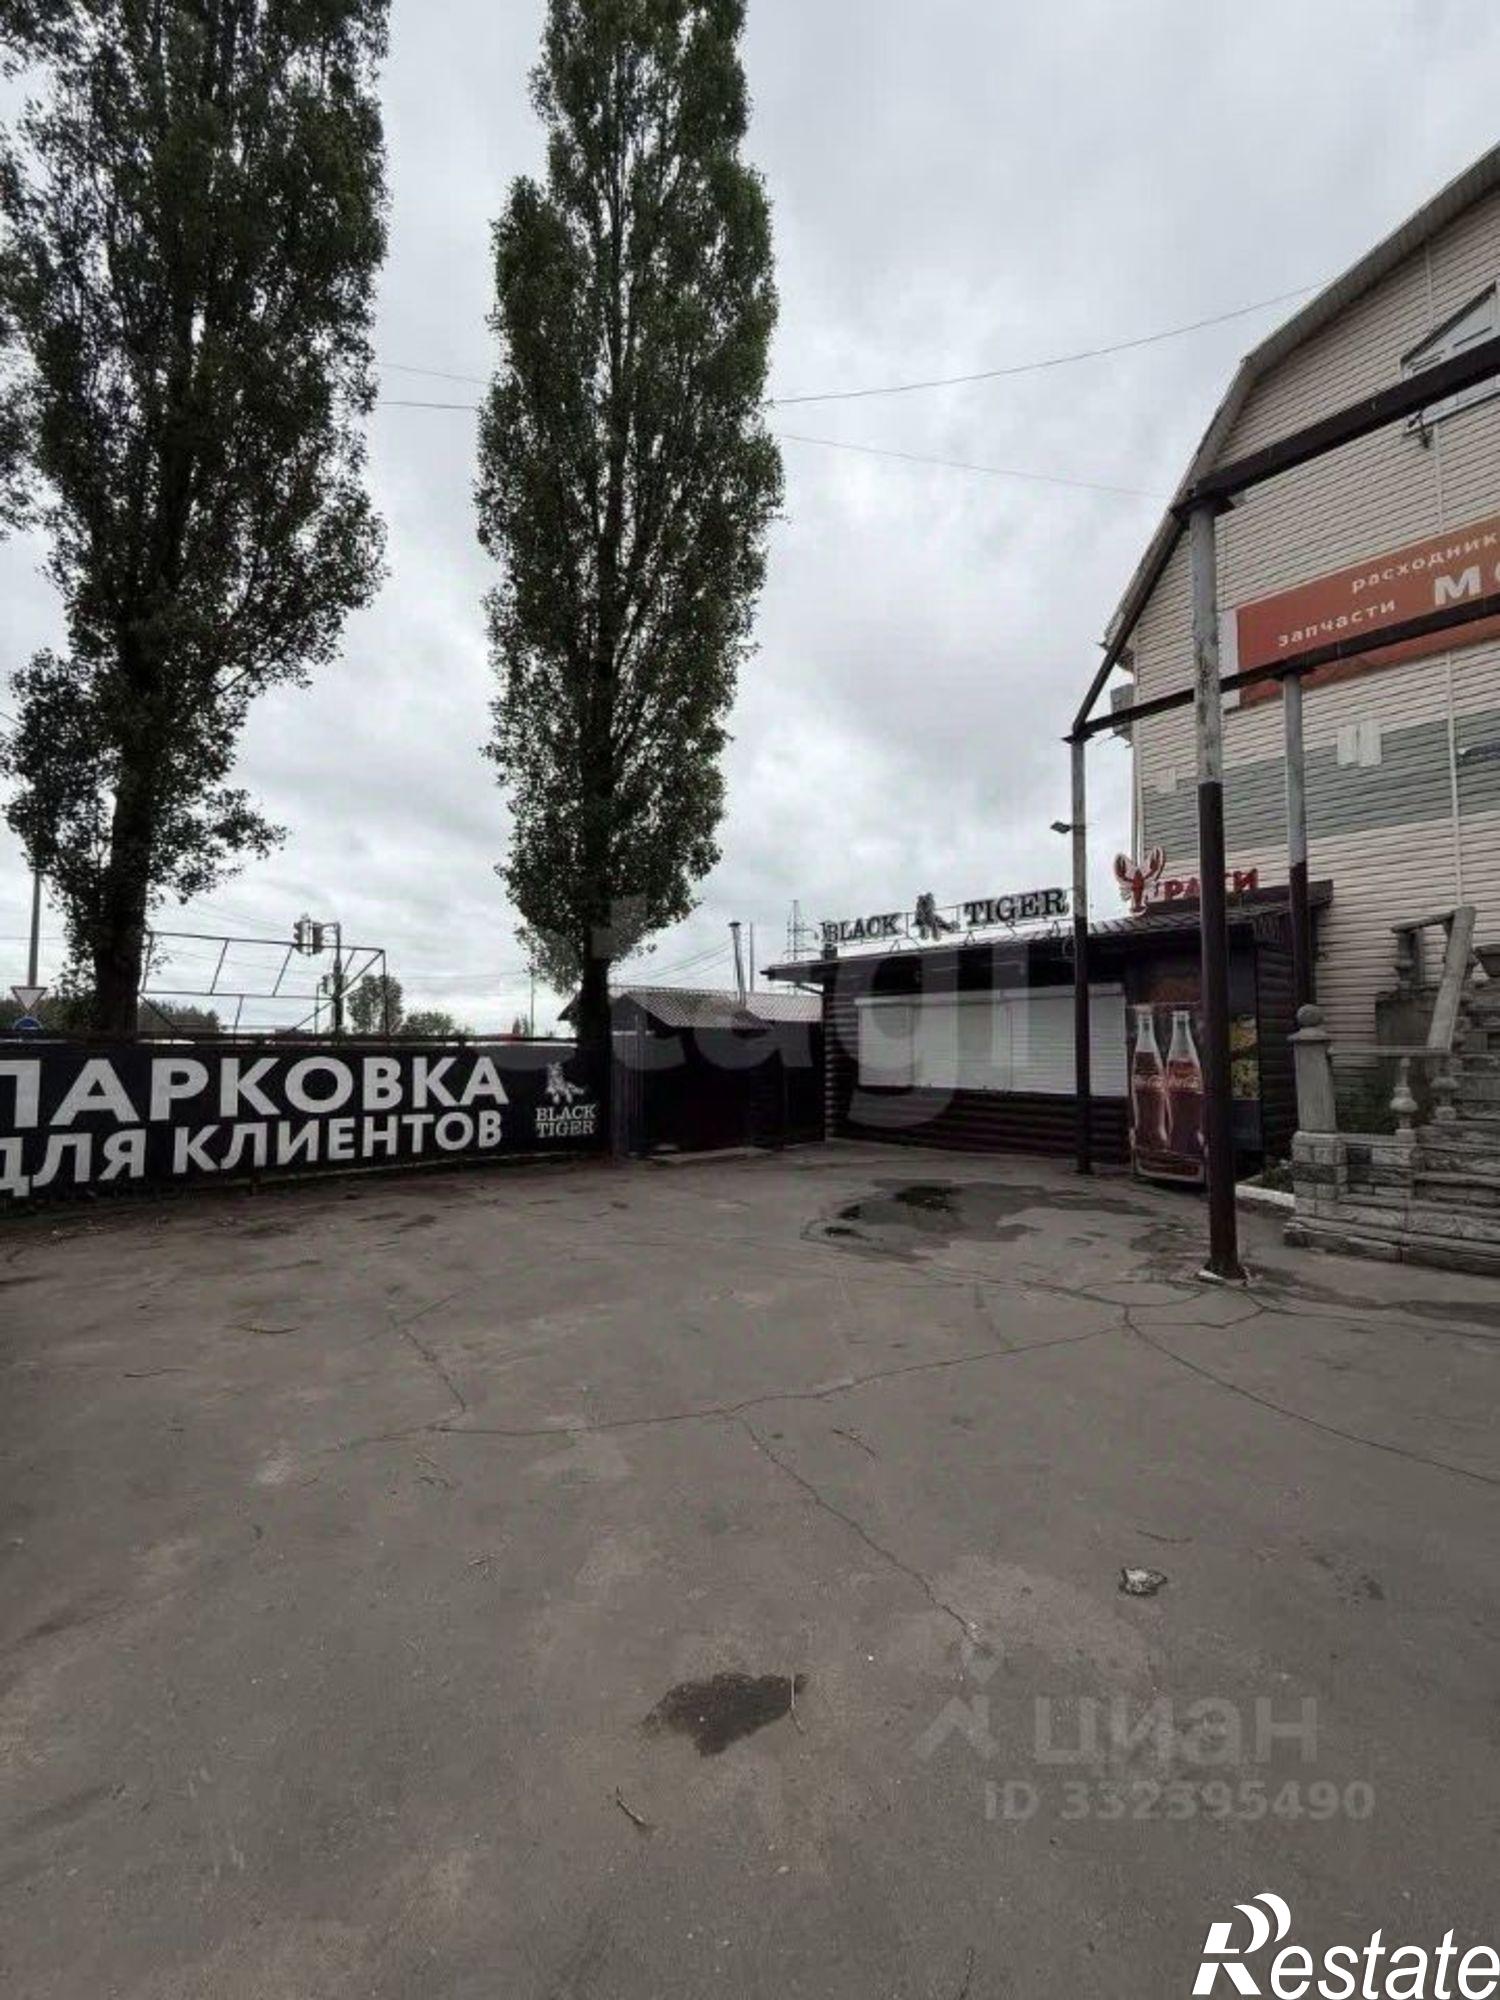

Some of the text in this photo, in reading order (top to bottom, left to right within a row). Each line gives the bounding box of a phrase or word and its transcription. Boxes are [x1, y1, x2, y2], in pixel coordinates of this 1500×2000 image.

[1433, 561, 1500, 606] М
[1276, 598, 1396, 648] запчасти
[821, 887, 1070, 943] BLACK TIGER
[0, 1055, 510, 1129] ПАРКОВКА
[535, 1104, 597, 1122] BLACK
[0, 1109, 503, 1197] ДЛЯ КЛИЕНТОВ
[536, 1119, 596, 1138] TIGER
